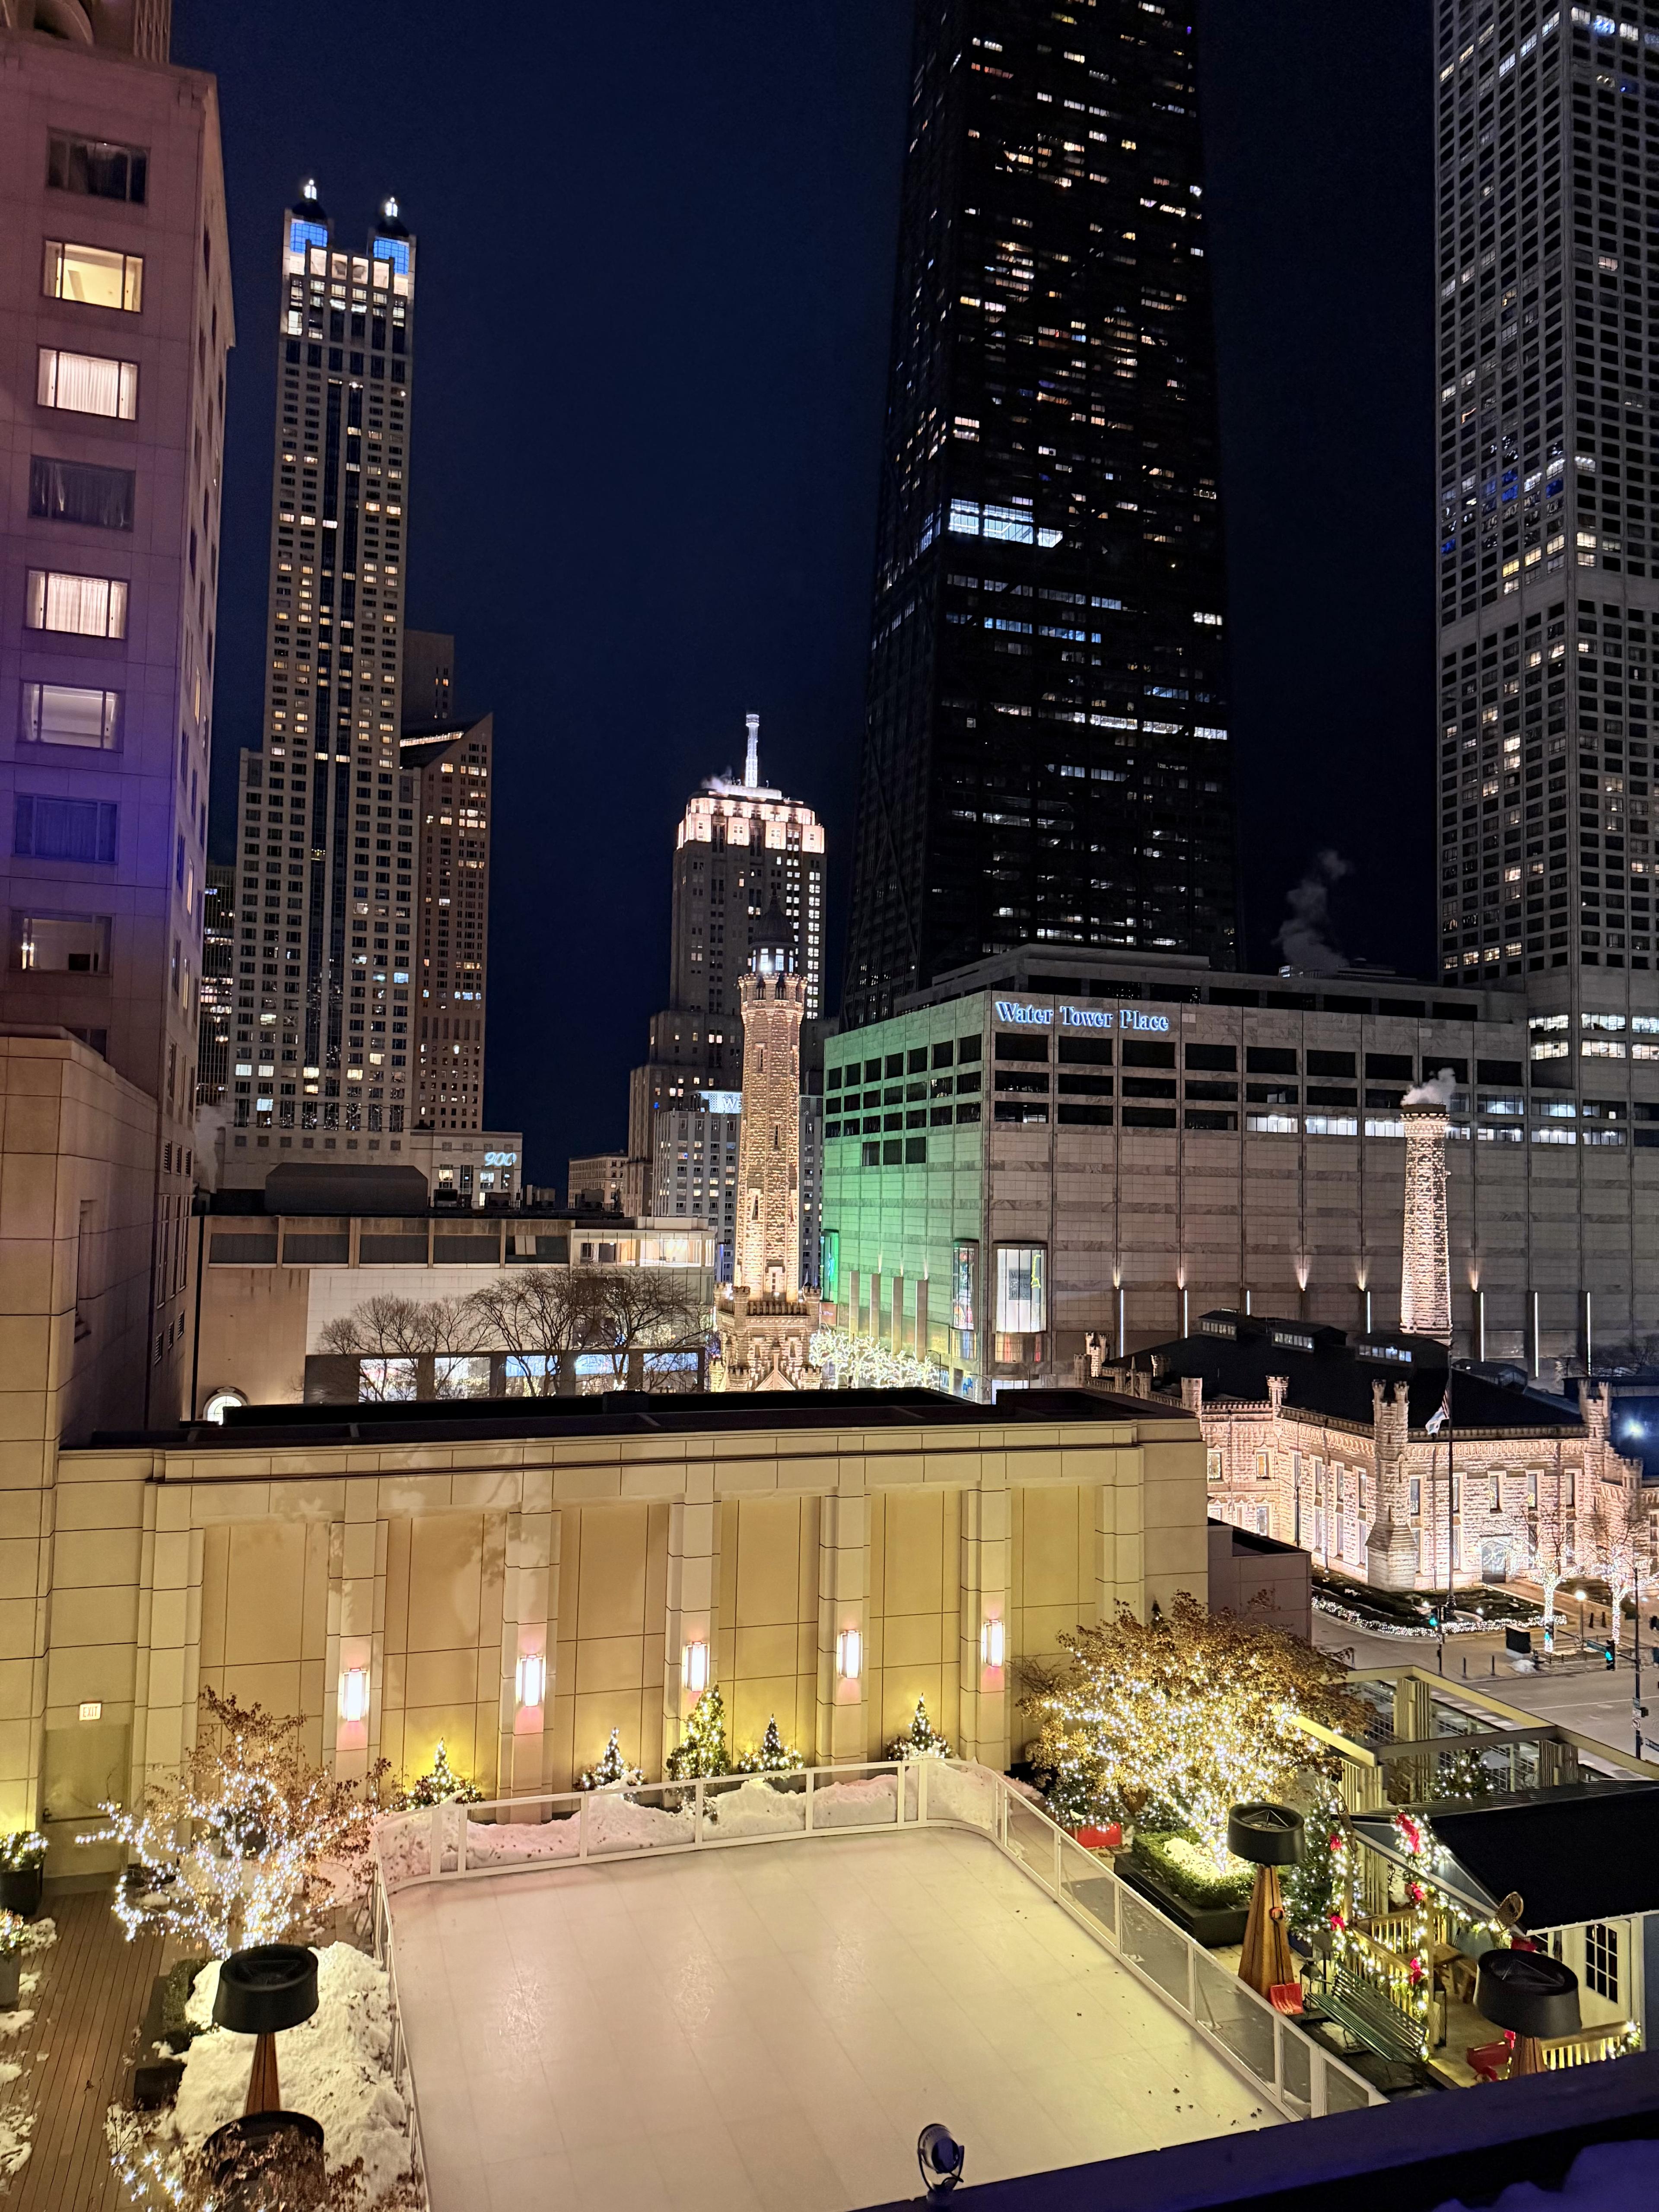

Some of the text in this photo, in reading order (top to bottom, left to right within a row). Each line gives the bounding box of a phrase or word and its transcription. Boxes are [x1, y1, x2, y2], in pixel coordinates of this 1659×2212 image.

[995, 1001, 1169, 1032] Water Tower Place
[485, 1152, 517, 1166] 900
[83, 1706, 98, 1717] EXIT
